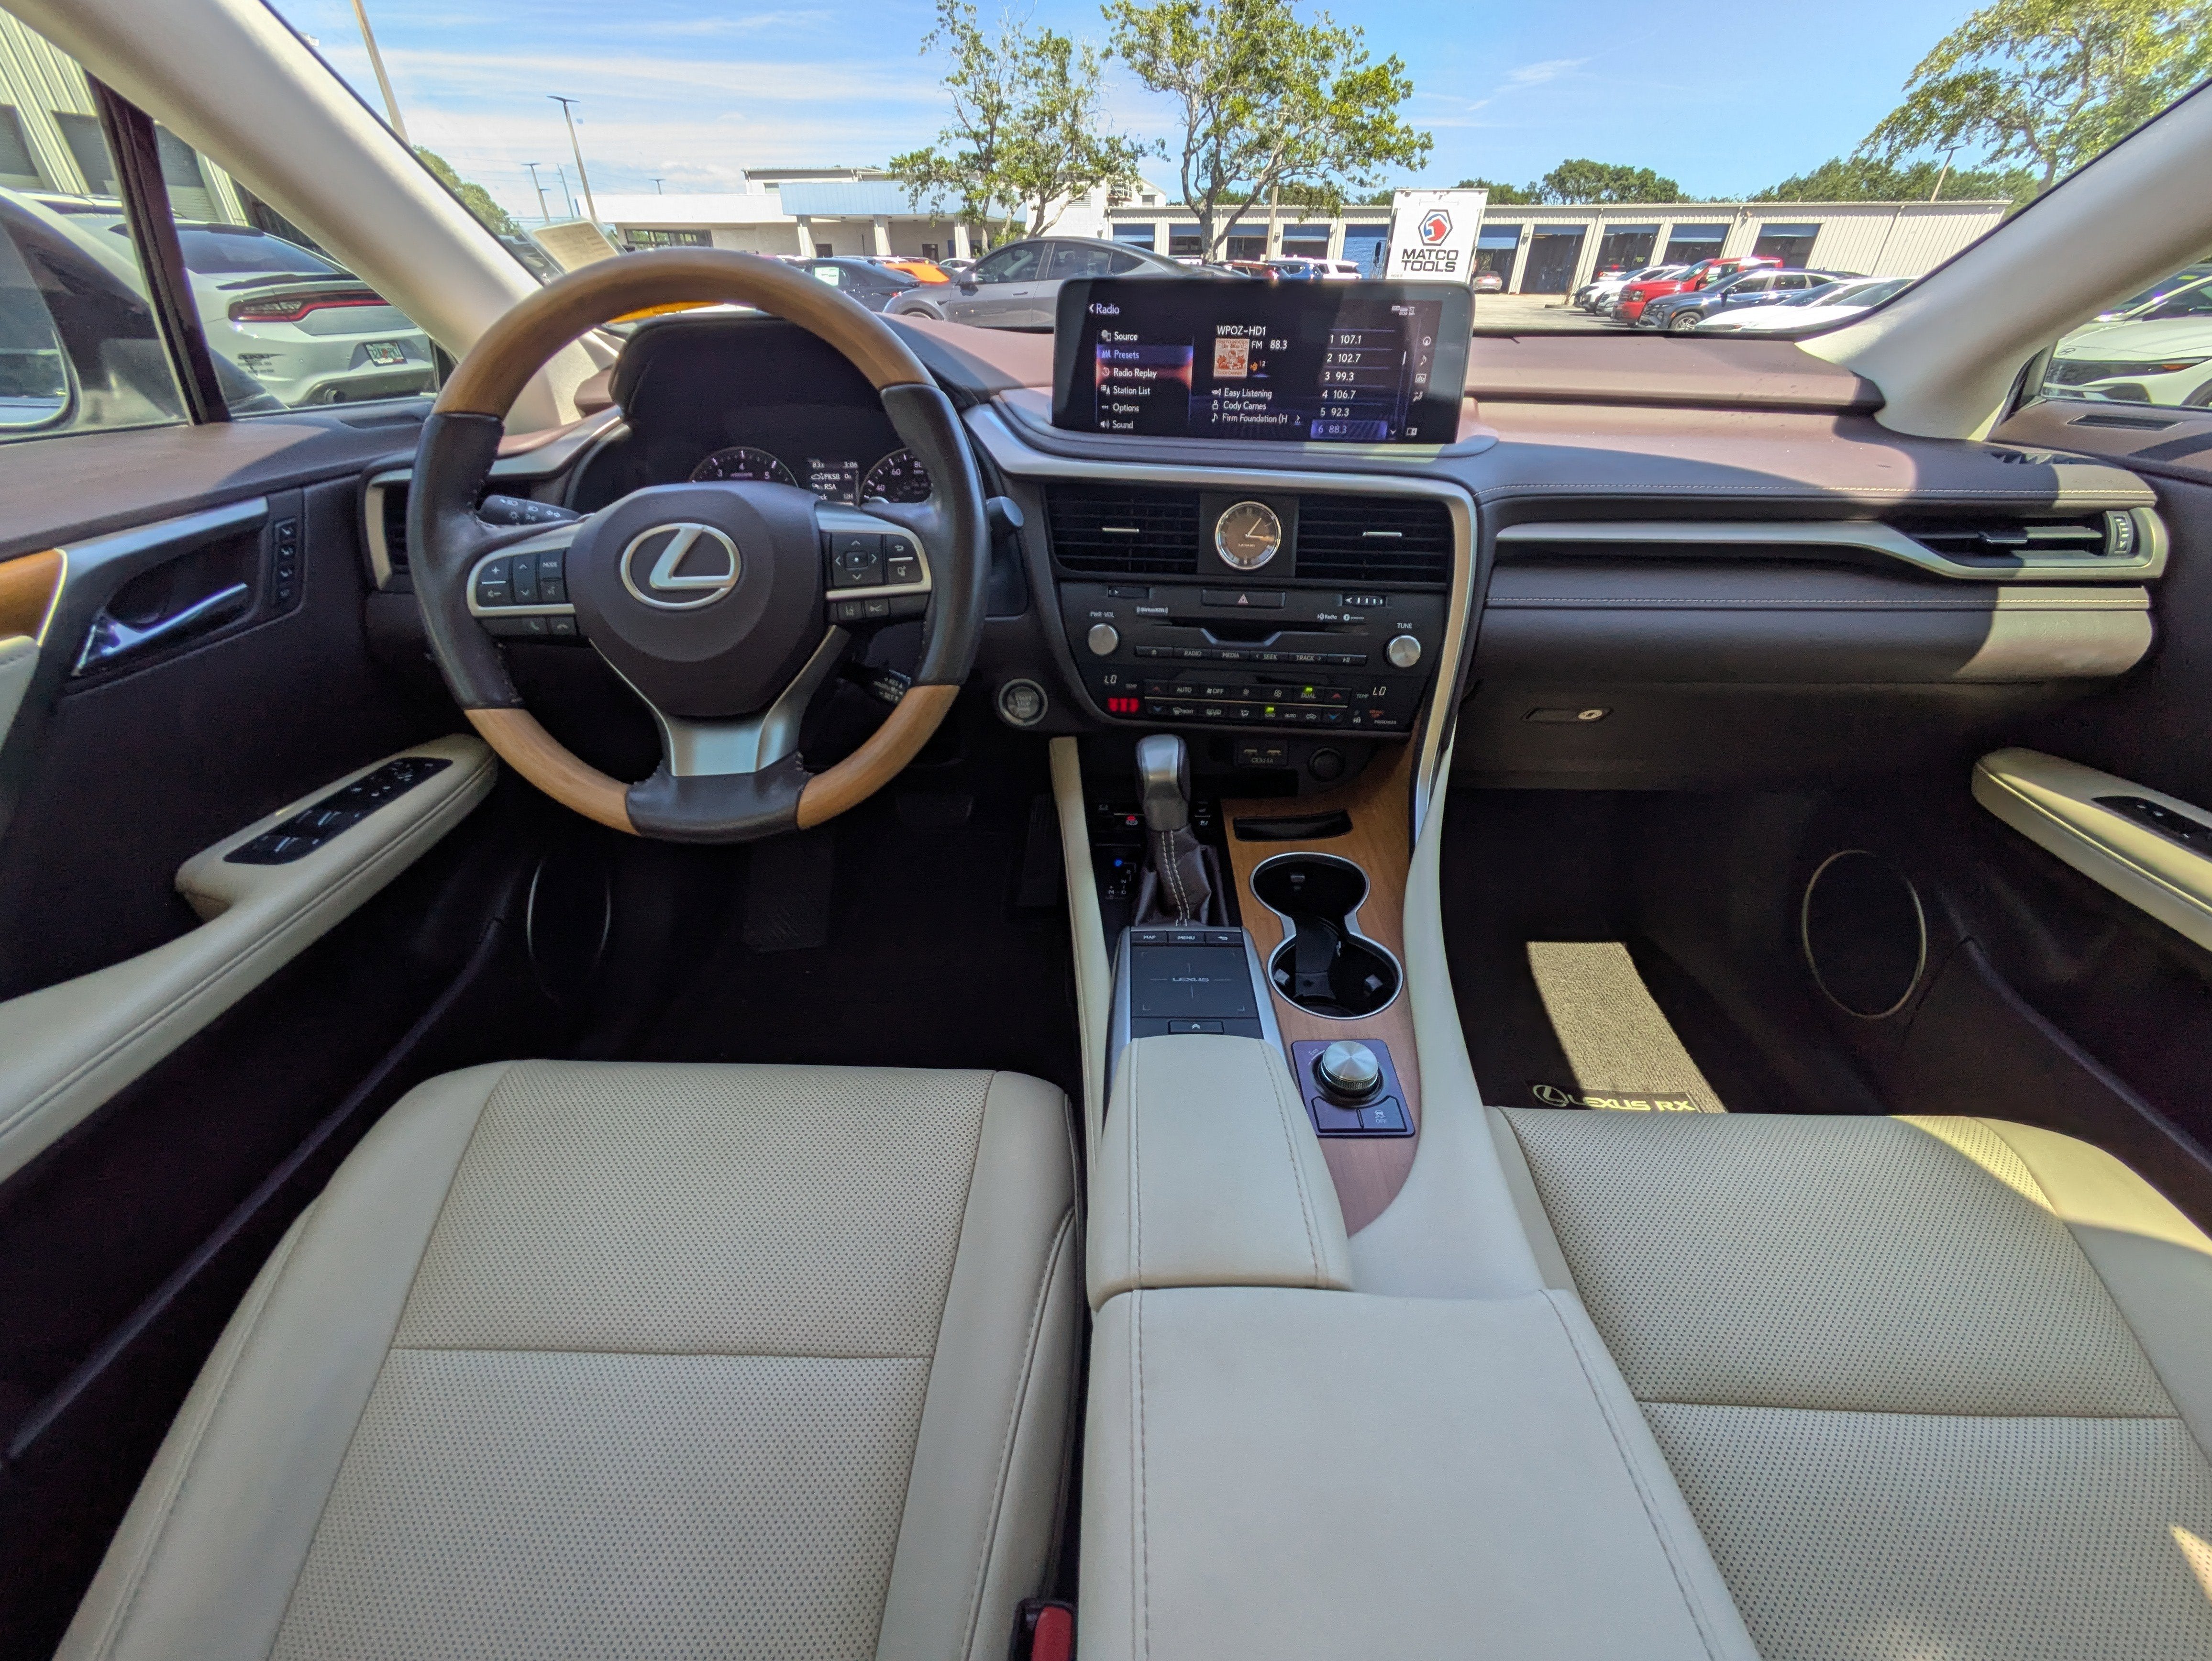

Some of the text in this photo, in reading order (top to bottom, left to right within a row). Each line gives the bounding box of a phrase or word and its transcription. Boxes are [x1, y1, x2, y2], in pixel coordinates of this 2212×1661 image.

[1402, 249, 1459, 260] MATCO
[1401, 260, 1456, 272] TOOLS
[1096, 303, 1120, 315] Radio
[1217, 325, 1266, 335] WPOZ-HD1
[1114, 330, 1138, 341] Source
[1330, 335, 1361, 344] 1 107.1
[1251, 341, 1262, 349] FM
[1114, 350, 1139, 360] Presets
[1327, 354, 1361, 363] 2 102.7
[1114, 368, 1157, 379] Radio Replay
[1325, 372, 1354, 381] 3 99.3
[1113, 387, 1150, 396] Station List
[1224, 388, 1272, 400] Easy Listening
[1322, 390, 1356, 399] 4 106.7
[1112, 403, 1139, 413] Options
[1223, 401, 1267, 412] Cody Carnes
[1331, 408, 1349, 416] 92.3
[1222, 414, 1238, 422] Firm
[1240, 414, 1277, 423] Foundation
[1112, 421, 1134, 429] Sound
[1328, 425, 1348, 433] 88.3
[1568, 1094, 1696, 1111] LEXUS RX
